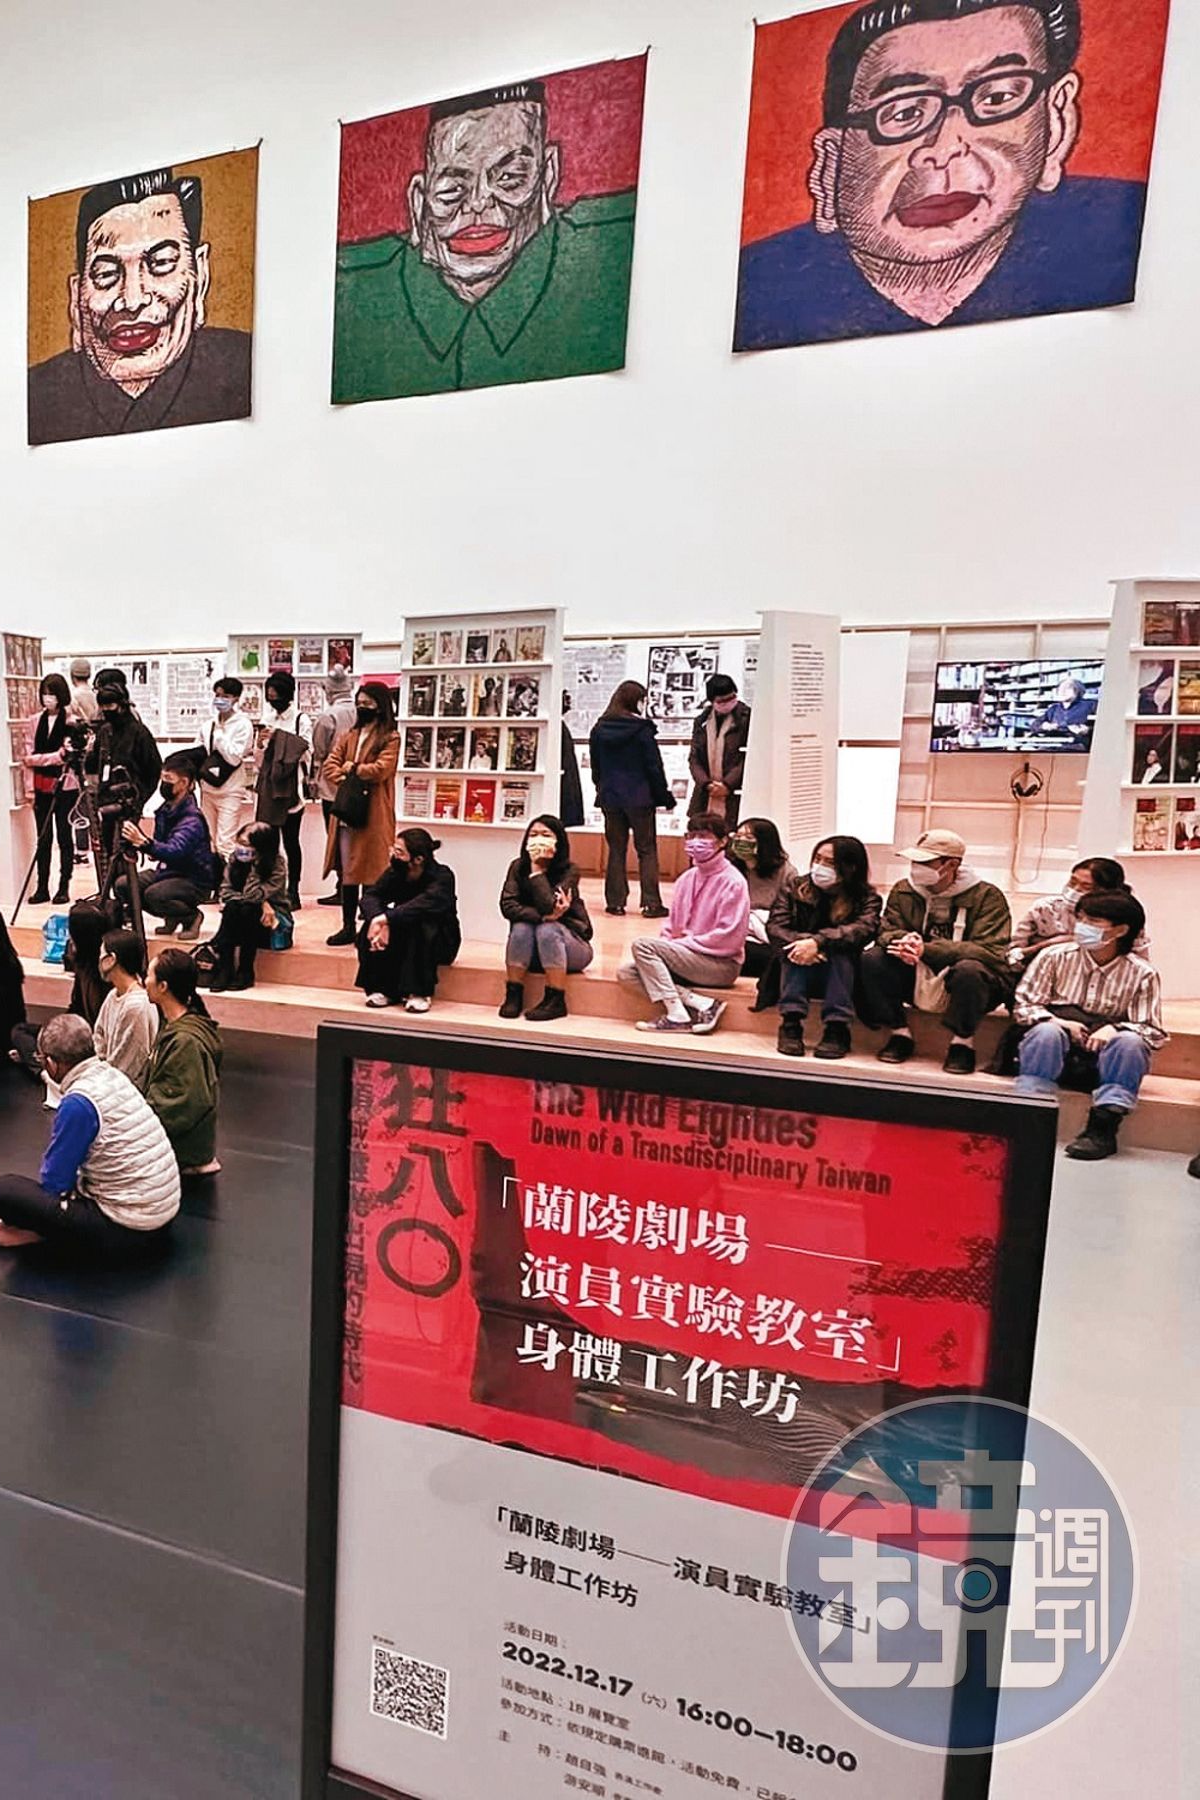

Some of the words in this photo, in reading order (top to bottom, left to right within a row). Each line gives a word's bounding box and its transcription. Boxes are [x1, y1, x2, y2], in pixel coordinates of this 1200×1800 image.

[531, 1117, 581, 1148] Dawn
[588, 1125, 609, 1152] of
[612, 1136, 624, 1157] a
[632, 1131, 809, 1189] Transdisciplinary
[816, 1157, 892, 1195] Taiwan
[516, 1323, 801, 1424] 身體工作坊
[503, 1551, 639, 1609] 身體工作坊
[502, 1641, 634, 1697] 2022.12.17
